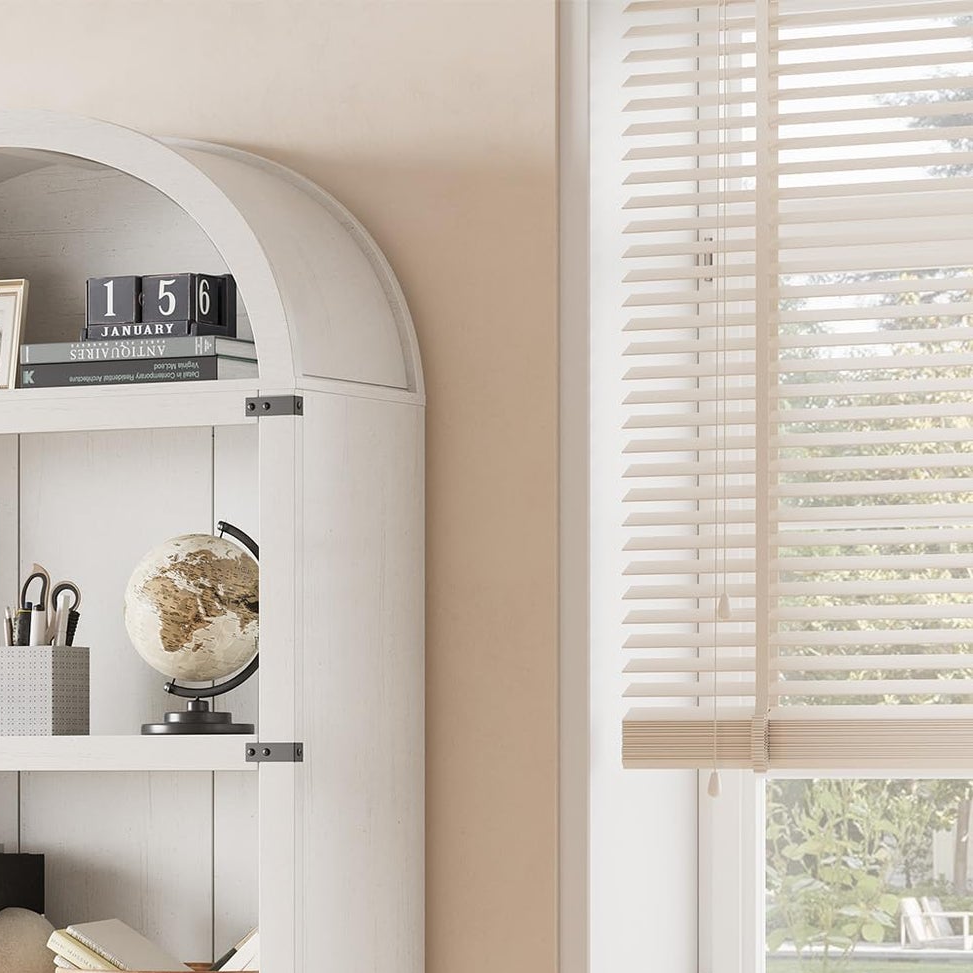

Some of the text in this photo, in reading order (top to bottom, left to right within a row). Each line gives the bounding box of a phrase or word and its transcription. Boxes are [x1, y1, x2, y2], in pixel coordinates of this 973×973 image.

[103, 278, 176, 317] 1 5
[198, 278, 210, 316] 6
[101, 323, 175, 337] JANUARY
[69, 344, 166, 361] ANTIQUAIRES
[153, 361, 200, 371] Virginia McLeod
[103, 374, 135, 382] Residential
[135, 371, 176, 381] Contemporary
[182, 370, 200, 378] Detail
[69, 375, 103, 384] Architecture
